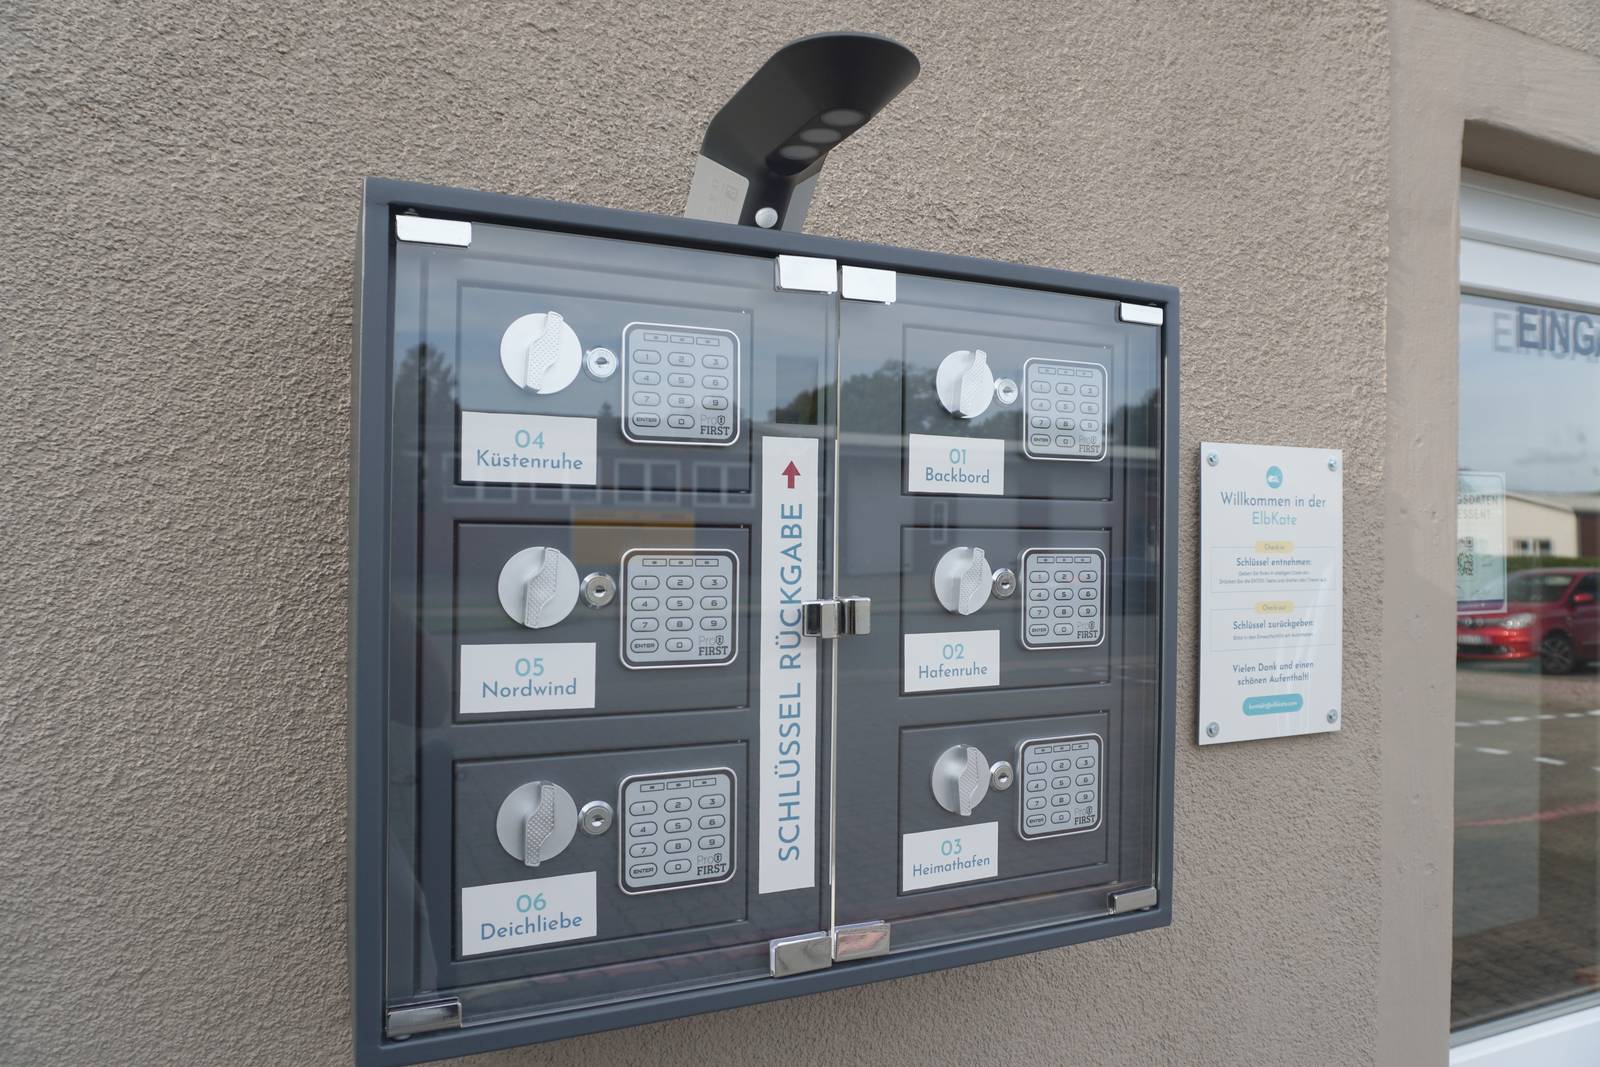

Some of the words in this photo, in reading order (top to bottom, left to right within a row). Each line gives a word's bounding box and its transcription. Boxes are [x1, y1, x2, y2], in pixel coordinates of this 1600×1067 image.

[1516, 305, 1600, 357] EING
[515, 430, 544, 448] 04
[700, 426, 730, 435] FIRST
[476, 448, 584, 470] Küstenruhe
[950, 448, 966, 464] 01
[926, 467, 990, 484] Backbord
[1221, 491, 1290, 507] Willkommen
[1295, 496, 1304, 507] in
[1308, 494, 1325, 507] der
[1252, 512, 1297, 525] ElbKate
[1236, 557, 1269, 566] Schlüssel
[774, 503, 802, 670] RÜCKGABE
[1233, 620, 1266, 630] Schlüssel
[699, 646, 728, 656] FIRST
[942, 643, 965, 660] 02
[515, 658, 544, 676] 05
[918, 662, 988, 679] Hafenruhe
[1232, 664, 1255, 672] Vielen
[1258, 662, 1277, 671] Dank
[1280, 661, 1292, 670] und
[1238, 676, 1267, 685] schönen
[1269, 672, 1309, 683] Aufenthalt!
[482, 678, 577, 698] Nordwind
[774, 682, 800, 861] SCHLÜSSEL
[1074, 815, 1095, 825] FIRST
[941, 838, 962, 856] 03
[697, 863, 726, 875] FIRST
[912, 855, 990, 877] Heimathafen
[516, 892, 546, 912] 06
[480, 912, 583, 940] Deichliebe
